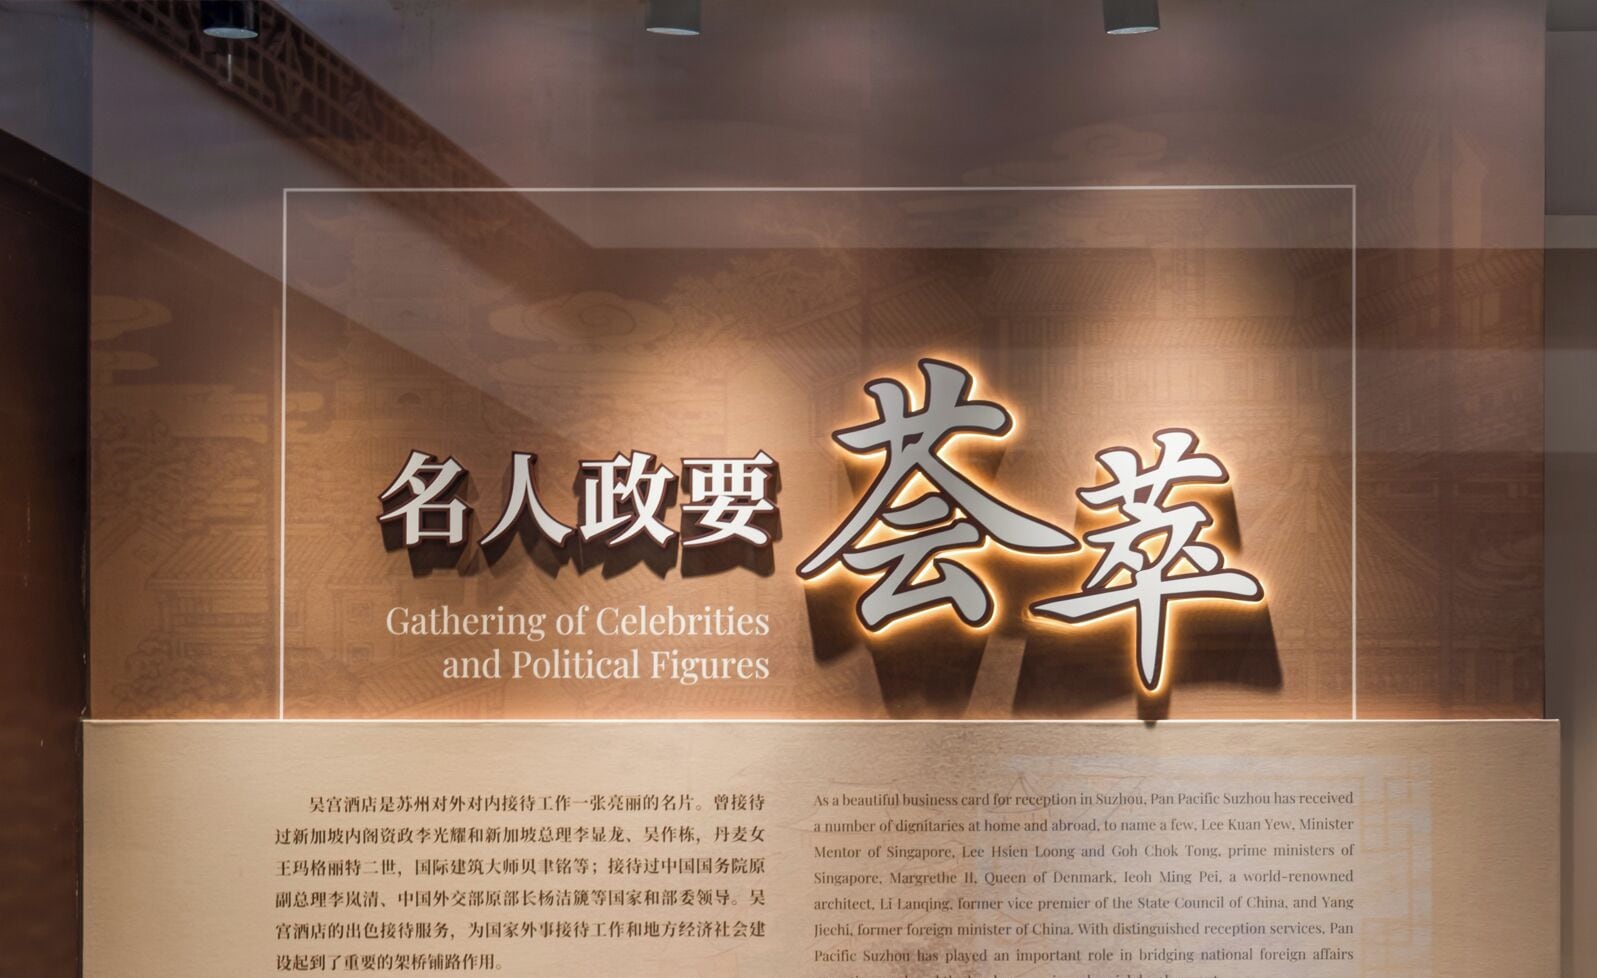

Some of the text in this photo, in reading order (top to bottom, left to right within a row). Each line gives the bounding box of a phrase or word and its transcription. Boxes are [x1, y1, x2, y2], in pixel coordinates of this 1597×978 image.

[379, 358, 1265, 690] 名人政要 荟萃
[385, 604, 770, 642] Gathering of Celebrities
[442, 648, 770, 686] and Political Figures
[813, 791, 1354, 809] As a beautiful business card for reception in Suzhou, Pan Pacific Suzhou has received
[813, 818, 1354, 836] a number of dignitaries at home and abroad, to name a few, Lee Kuan Yew, Minister
[813, 843, 1355, 862] Mentor of Singapore, Lee Hsien Loong and Goh Chok Tong, prime ministers of
[813, 869, 1354, 888] Singapore, Margrethe II, Queen of Denmark, Ieoh Ming Pei, a world-renowned
[813, 895, 1354, 913] architect, Li Lanqing, former vice premier of the State Council of China, and Yang
[813, 922, 1354, 940] Jiechi, former foreign minister of China. With distinguished reception services, Pan
[275, 953, 503, 972] 设起到了重要的架桥铺路作用。
[813, 947, 1354, 965] Pacific Suzhou has played an important role in bridging national foreign affairs
